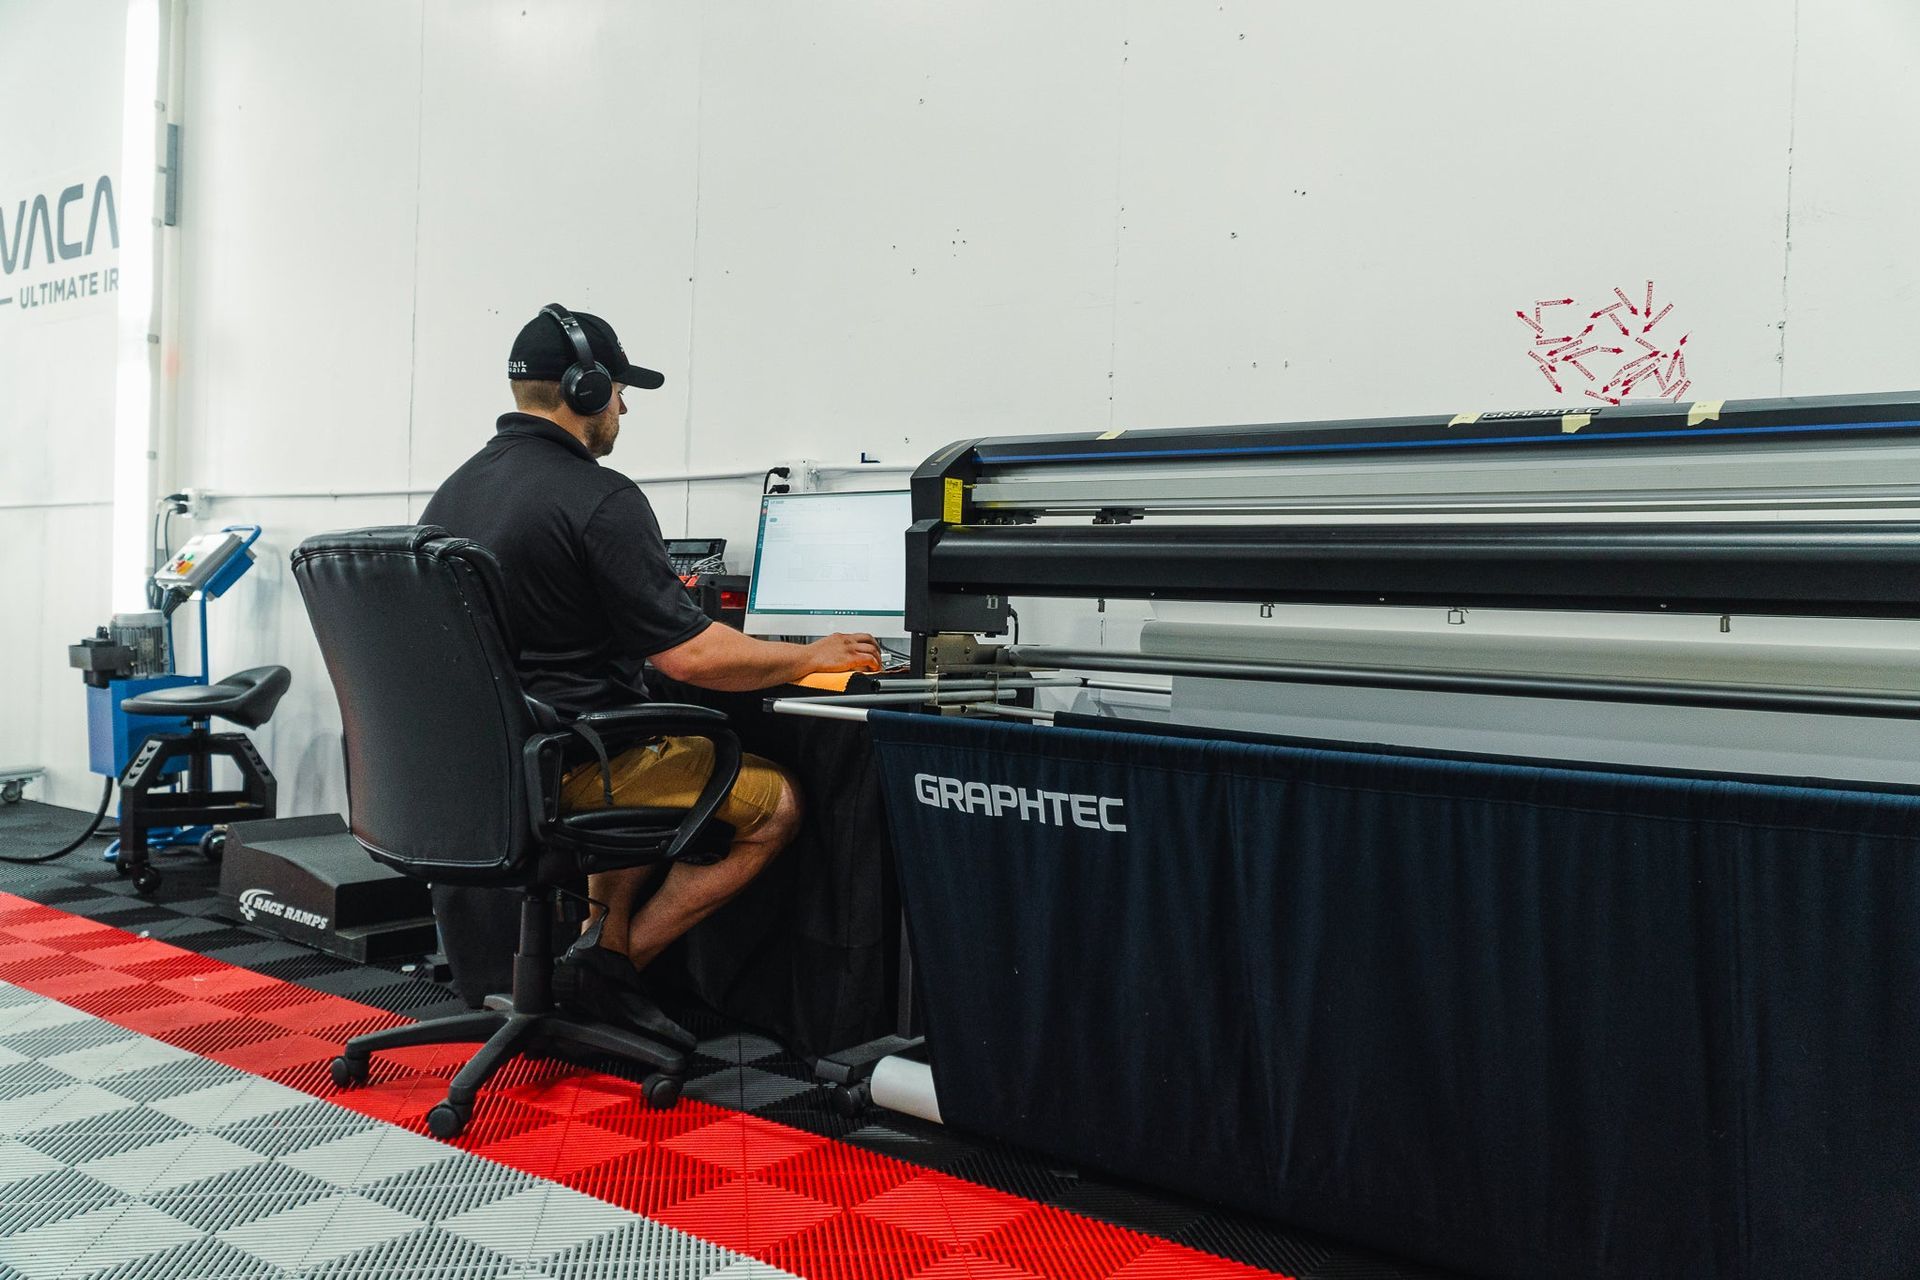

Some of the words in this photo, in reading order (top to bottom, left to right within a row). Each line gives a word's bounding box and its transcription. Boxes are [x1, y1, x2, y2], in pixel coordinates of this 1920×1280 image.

[20, 272, 99, 309] ULTIMATE
[914, 773, 1127, 832] GRAPHTEC
[253, 897, 285, 917] RACE
[284, 906, 329, 930] RAMPS
